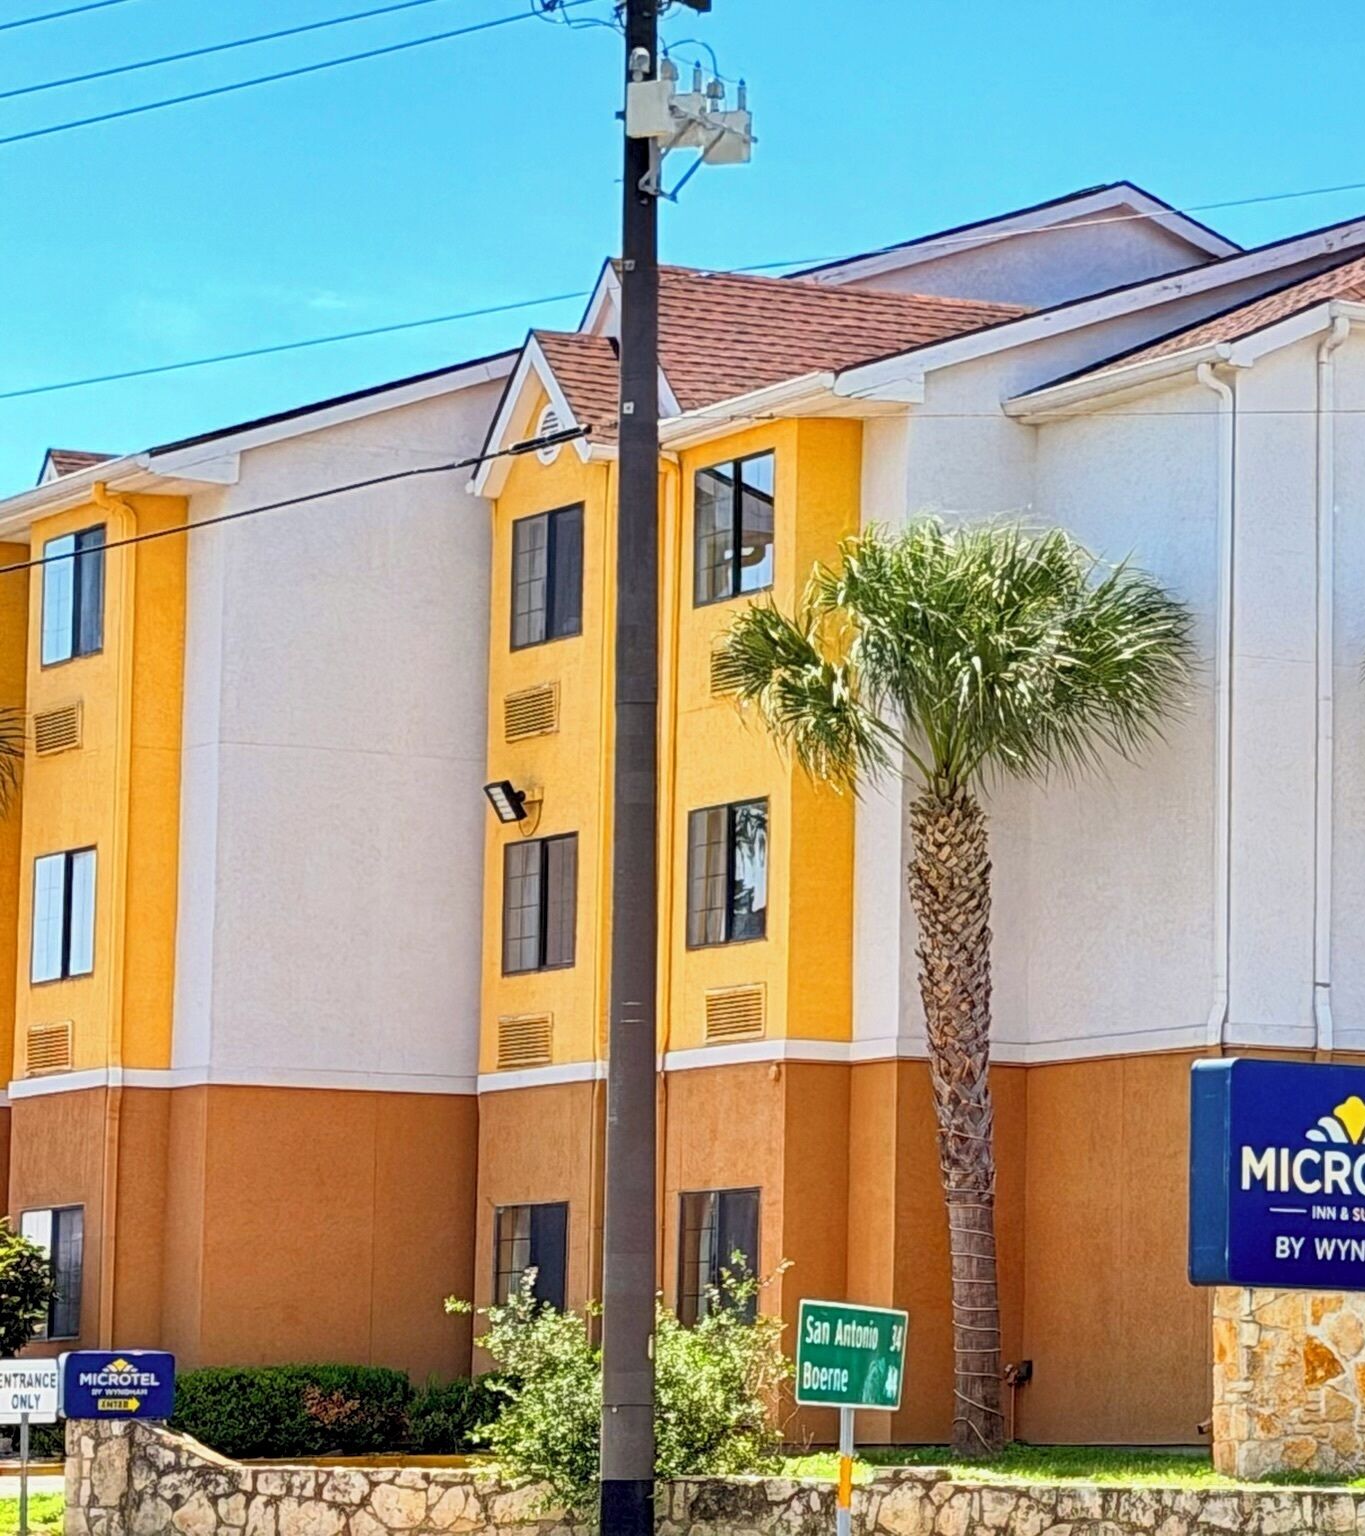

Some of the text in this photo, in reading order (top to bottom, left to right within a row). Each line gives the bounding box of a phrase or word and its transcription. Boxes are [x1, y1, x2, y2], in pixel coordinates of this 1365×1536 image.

[1311, 1205, 1337, 1221] INN
[1340, 1207, 1349, 1221] &
[1275, 1236, 1305, 1259] BY
[805, 1315, 830, 1345] San
[834, 1318, 878, 1350] Antonio
[79, 1372, 160, 1386] MICROTEL
[802, 1361, 849, 1392] Boerne
[91, 1388, 148, 1396] BY WYNDHAM
[11, 1394, 41, 1409] ONLY
[101, 1399, 129, 1409] ENTER
